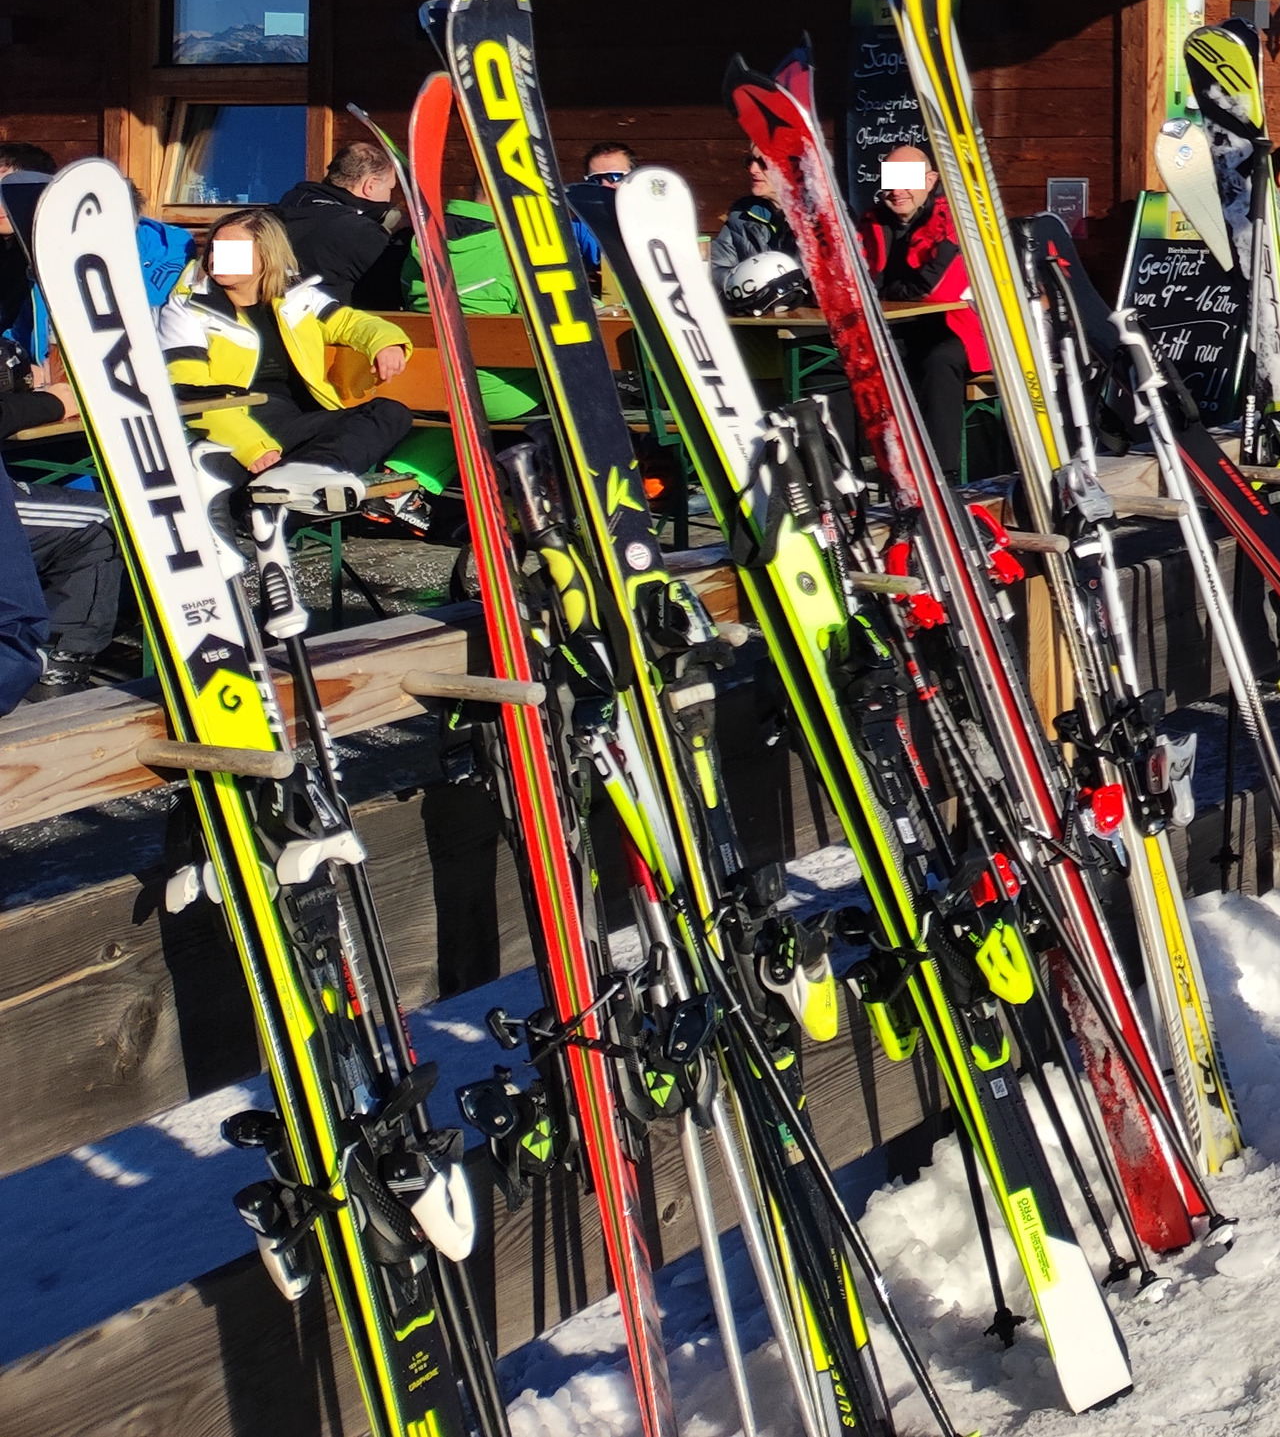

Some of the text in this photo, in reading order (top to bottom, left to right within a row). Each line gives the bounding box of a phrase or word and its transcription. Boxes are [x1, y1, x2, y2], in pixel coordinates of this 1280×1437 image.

[856, 89, 919, 116] Spareribs
[876, 113, 897, 126] mit
[472, 39, 593, 347] HEAD
[1138, 253, 1206, 285] Geöffnet
[1133, 291, 1156, 307] von
[647, 237, 739, 419] HEAD
[1194, 343, 1223, 364] nur
[73, 252, 204, 574] HEAD
[1243, 395, 1256, 455] PRIMACY
[181, 597, 217, 612] SHAPE
[184, 605, 222, 627] SX
[201, 647, 231, 664] 156
[558, 643, 588, 679] FISCHER
[250, 663, 284, 733] LEKI
[1021, 1197, 1036, 1223] PRO
